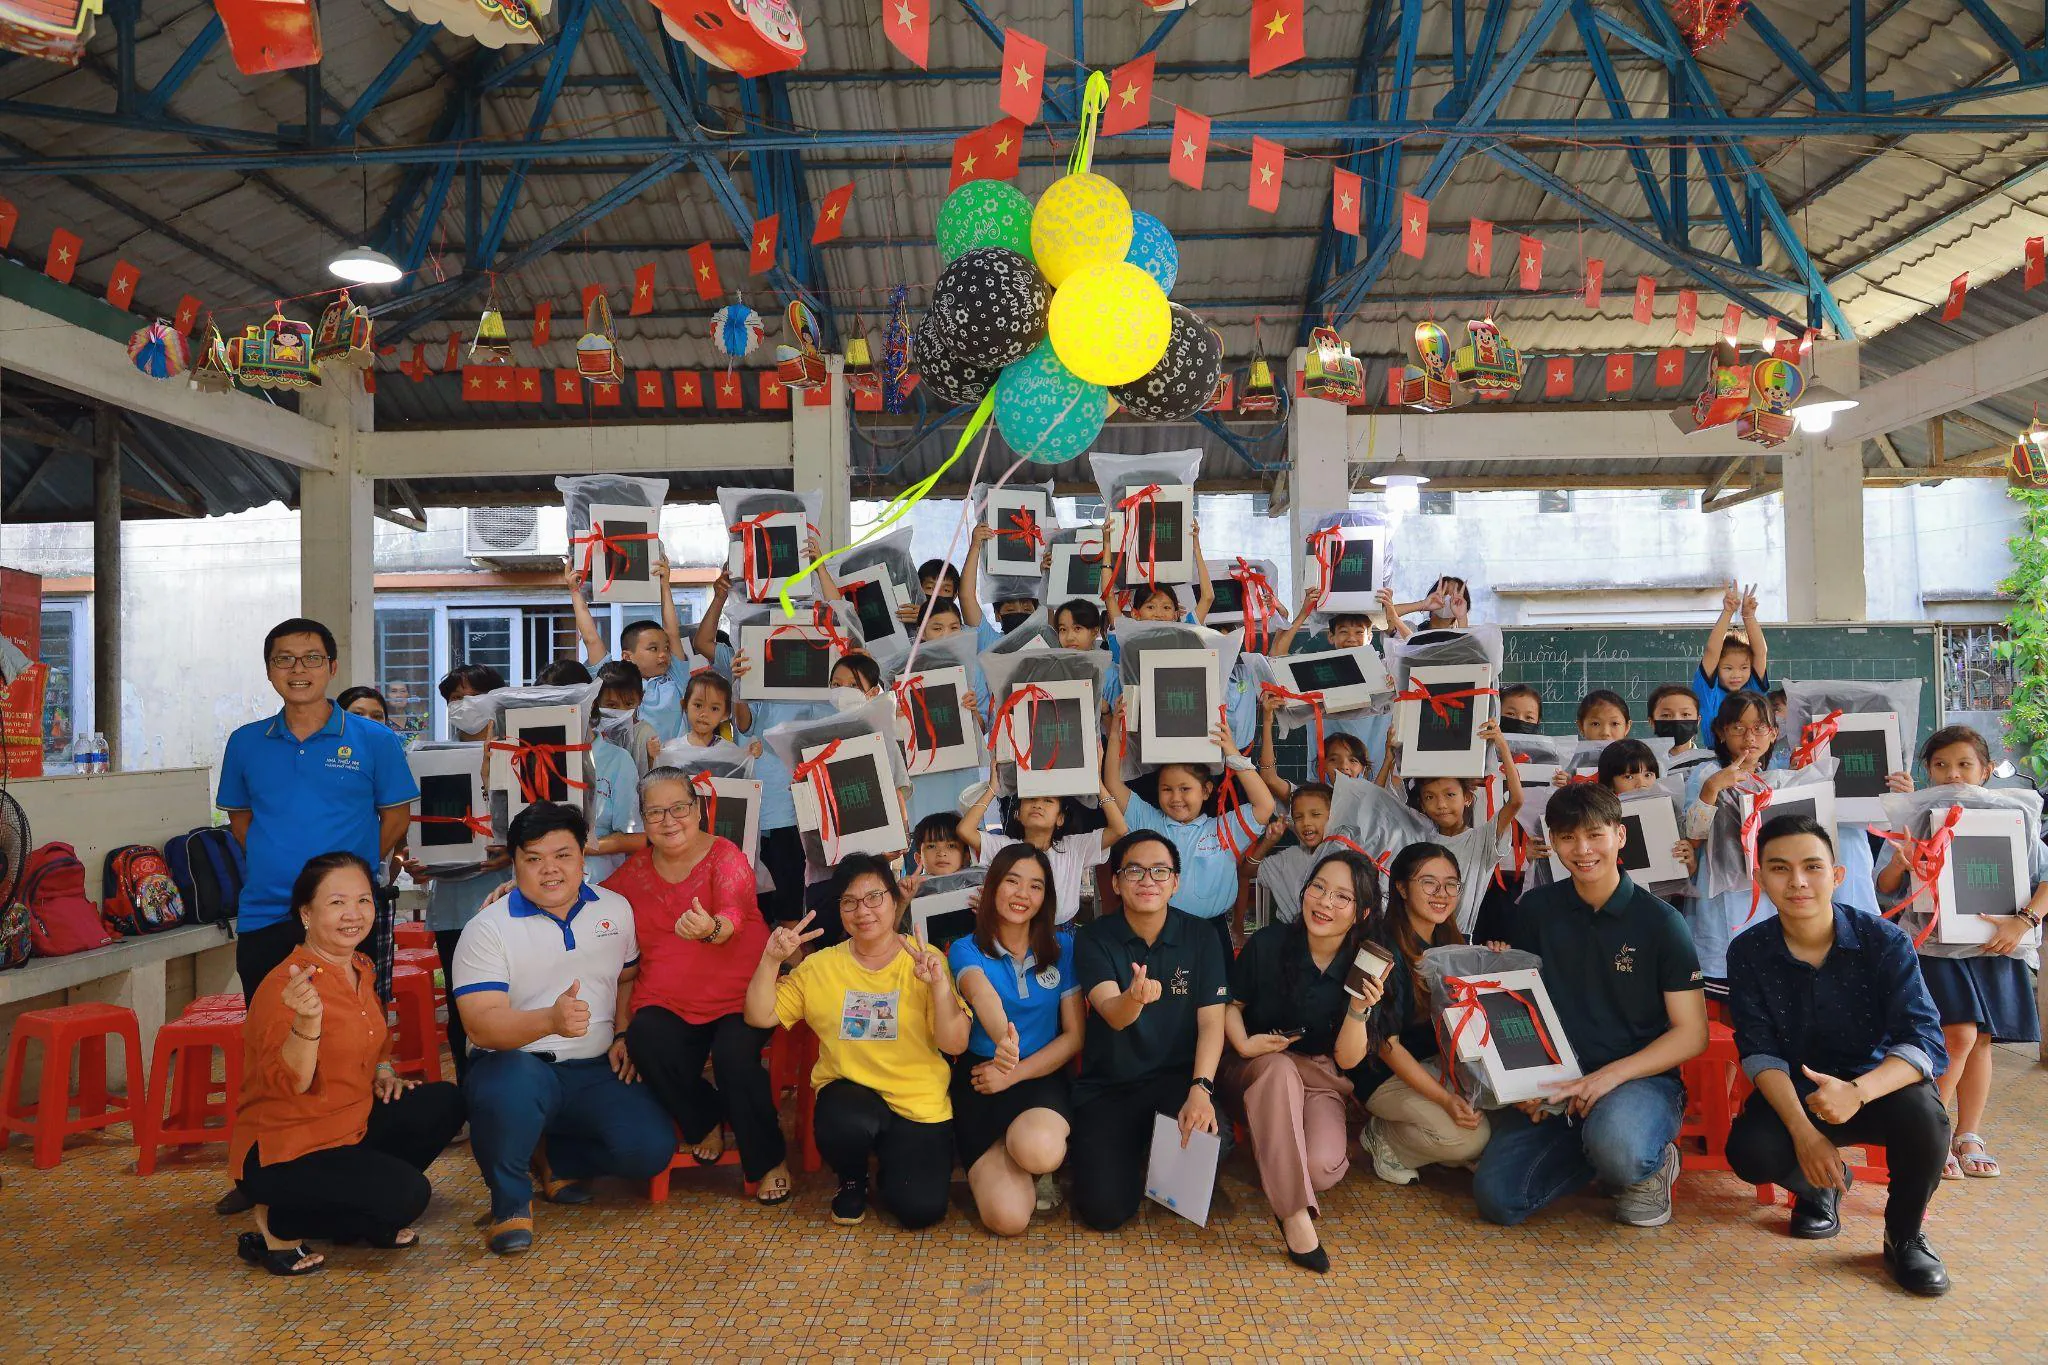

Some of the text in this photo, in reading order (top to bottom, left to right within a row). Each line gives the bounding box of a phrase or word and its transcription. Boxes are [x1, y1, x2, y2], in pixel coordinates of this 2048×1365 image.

[999, 275, 1020, 317] HAPPY
[1164, 340, 1191, 385] HAPPY
[1015, 394, 1057, 408] HAPPY
[1614, 962, 1633, 973] Tek
[1170, 986, 1188, 995] Tek
